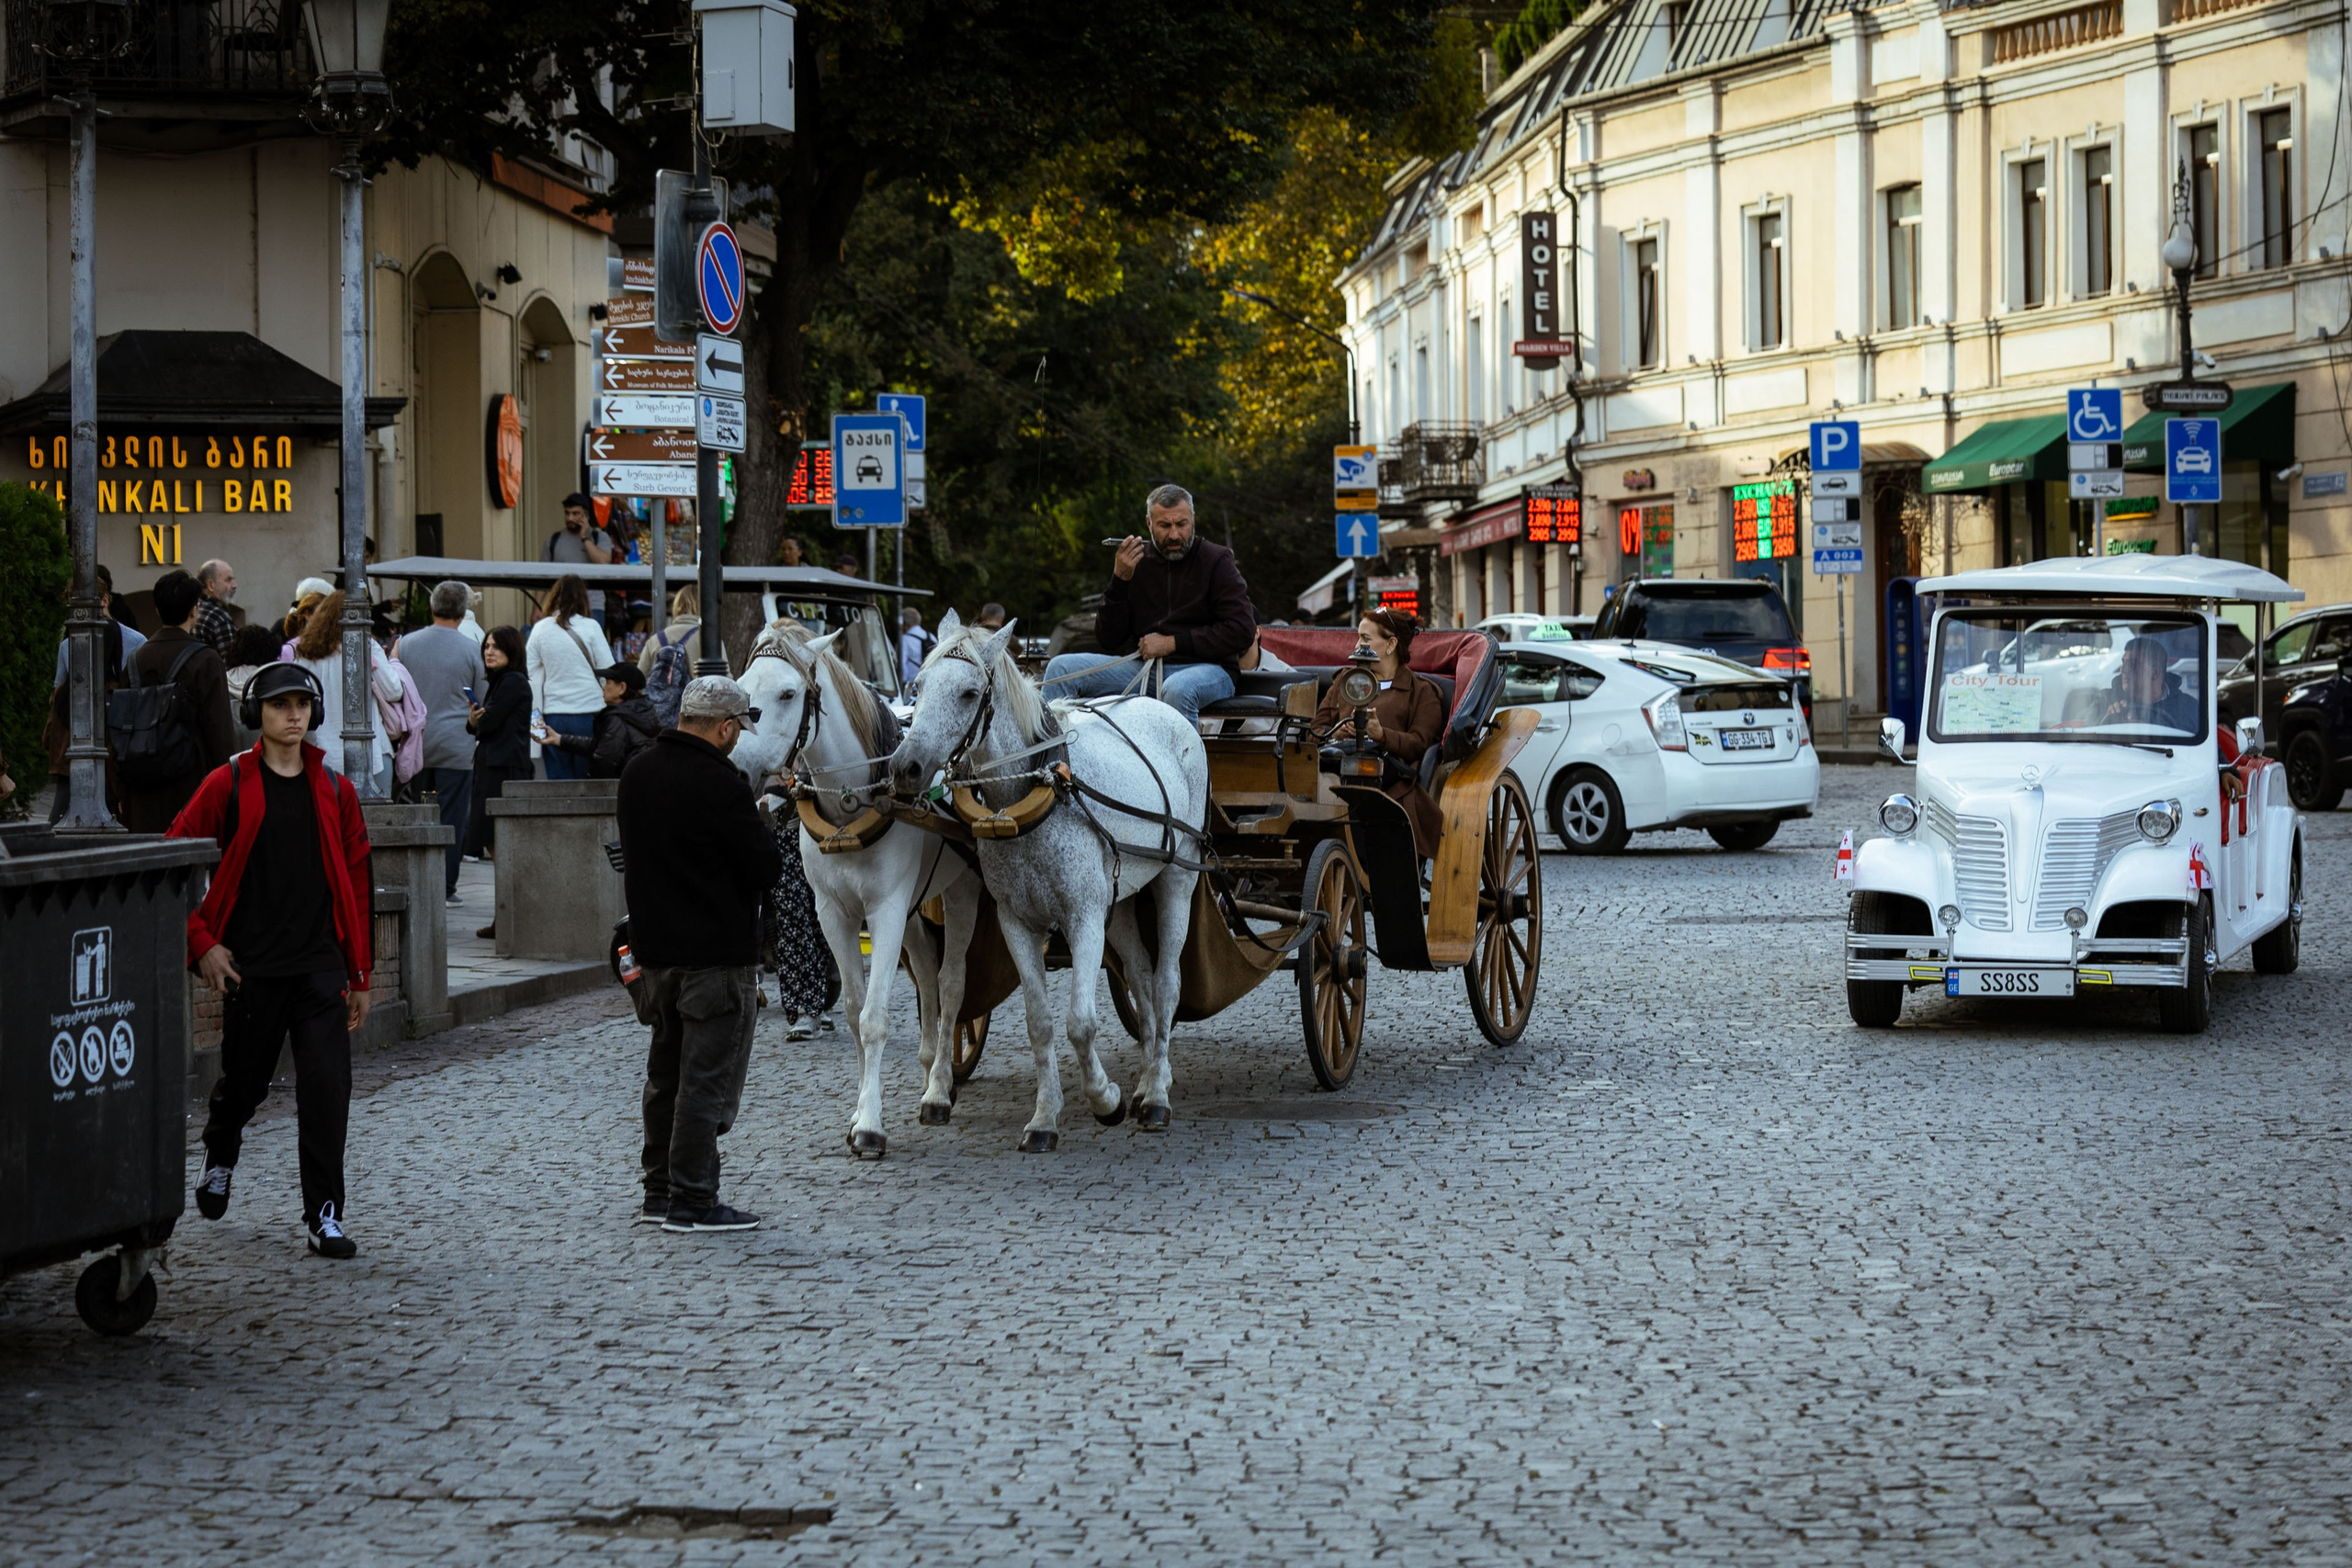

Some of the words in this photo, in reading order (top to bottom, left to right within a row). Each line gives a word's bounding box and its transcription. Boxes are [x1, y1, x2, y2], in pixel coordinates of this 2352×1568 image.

[1531, 219, 1551, 333] HOTEL
[631, 312, 650, 321] Church
[654, 344, 685, 354] Narikala
[654, 415, 689, 423] Botanical
[845, 434, 891, 446] ტაქსი
[1820, 426, 1849, 467] P
[29, 435, 187, 468] ხიკლის
[206, 435, 292, 468] ბარი
[1988, 462, 2024, 477] Europcar
[224, 479, 292, 513] BAR
[633, 483, 655, 492] Surb
[657, 484, 687, 495] Gevorg
[1758, 517, 1771, 539] EUR
[1770, 515, 1795, 537] 2.915
[2106, 537, 2158, 556] Europcar
[787, 602, 827, 619] CITY
[1544, 624, 1562, 632] TAXI
[1951, 675, 1988, 687] City
[1997, 674, 2040, 687] Tour
[1948, 983, 1959, 992] GE
[1980, 972, 2040, 993] SS8SS
